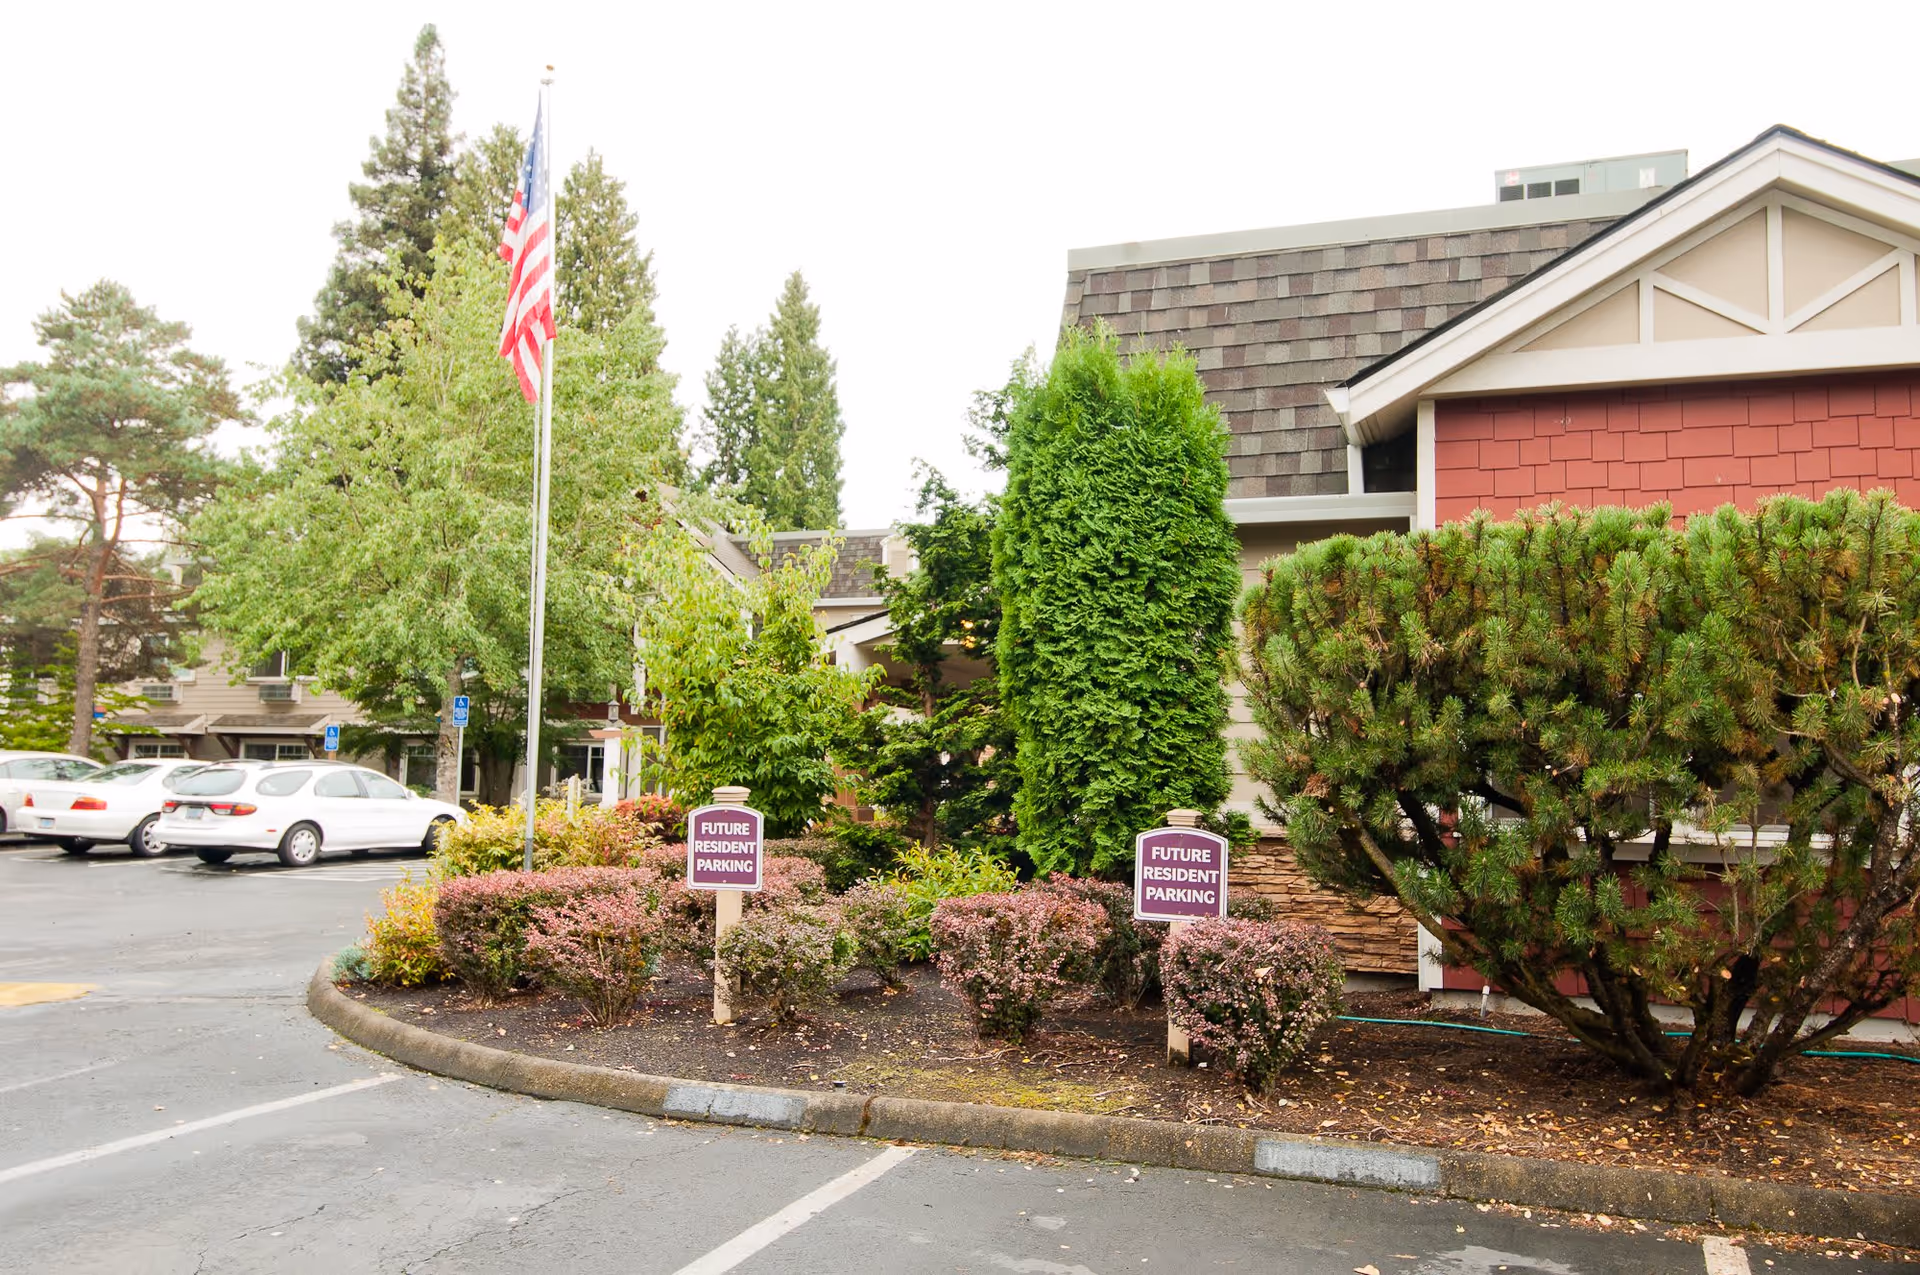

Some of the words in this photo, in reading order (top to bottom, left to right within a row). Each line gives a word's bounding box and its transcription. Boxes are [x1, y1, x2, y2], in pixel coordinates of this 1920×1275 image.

[701, 822, 750, 835] FUTURE
[694, 840, 756, 854] RESIDENT
[1151, 846, 1211, 863] FUTURE
[696, 858, 753, 873] PARKING
[1143, 866, 1219, 884] RESIDENT
[1145, 886, 1215, 905] PARKING
